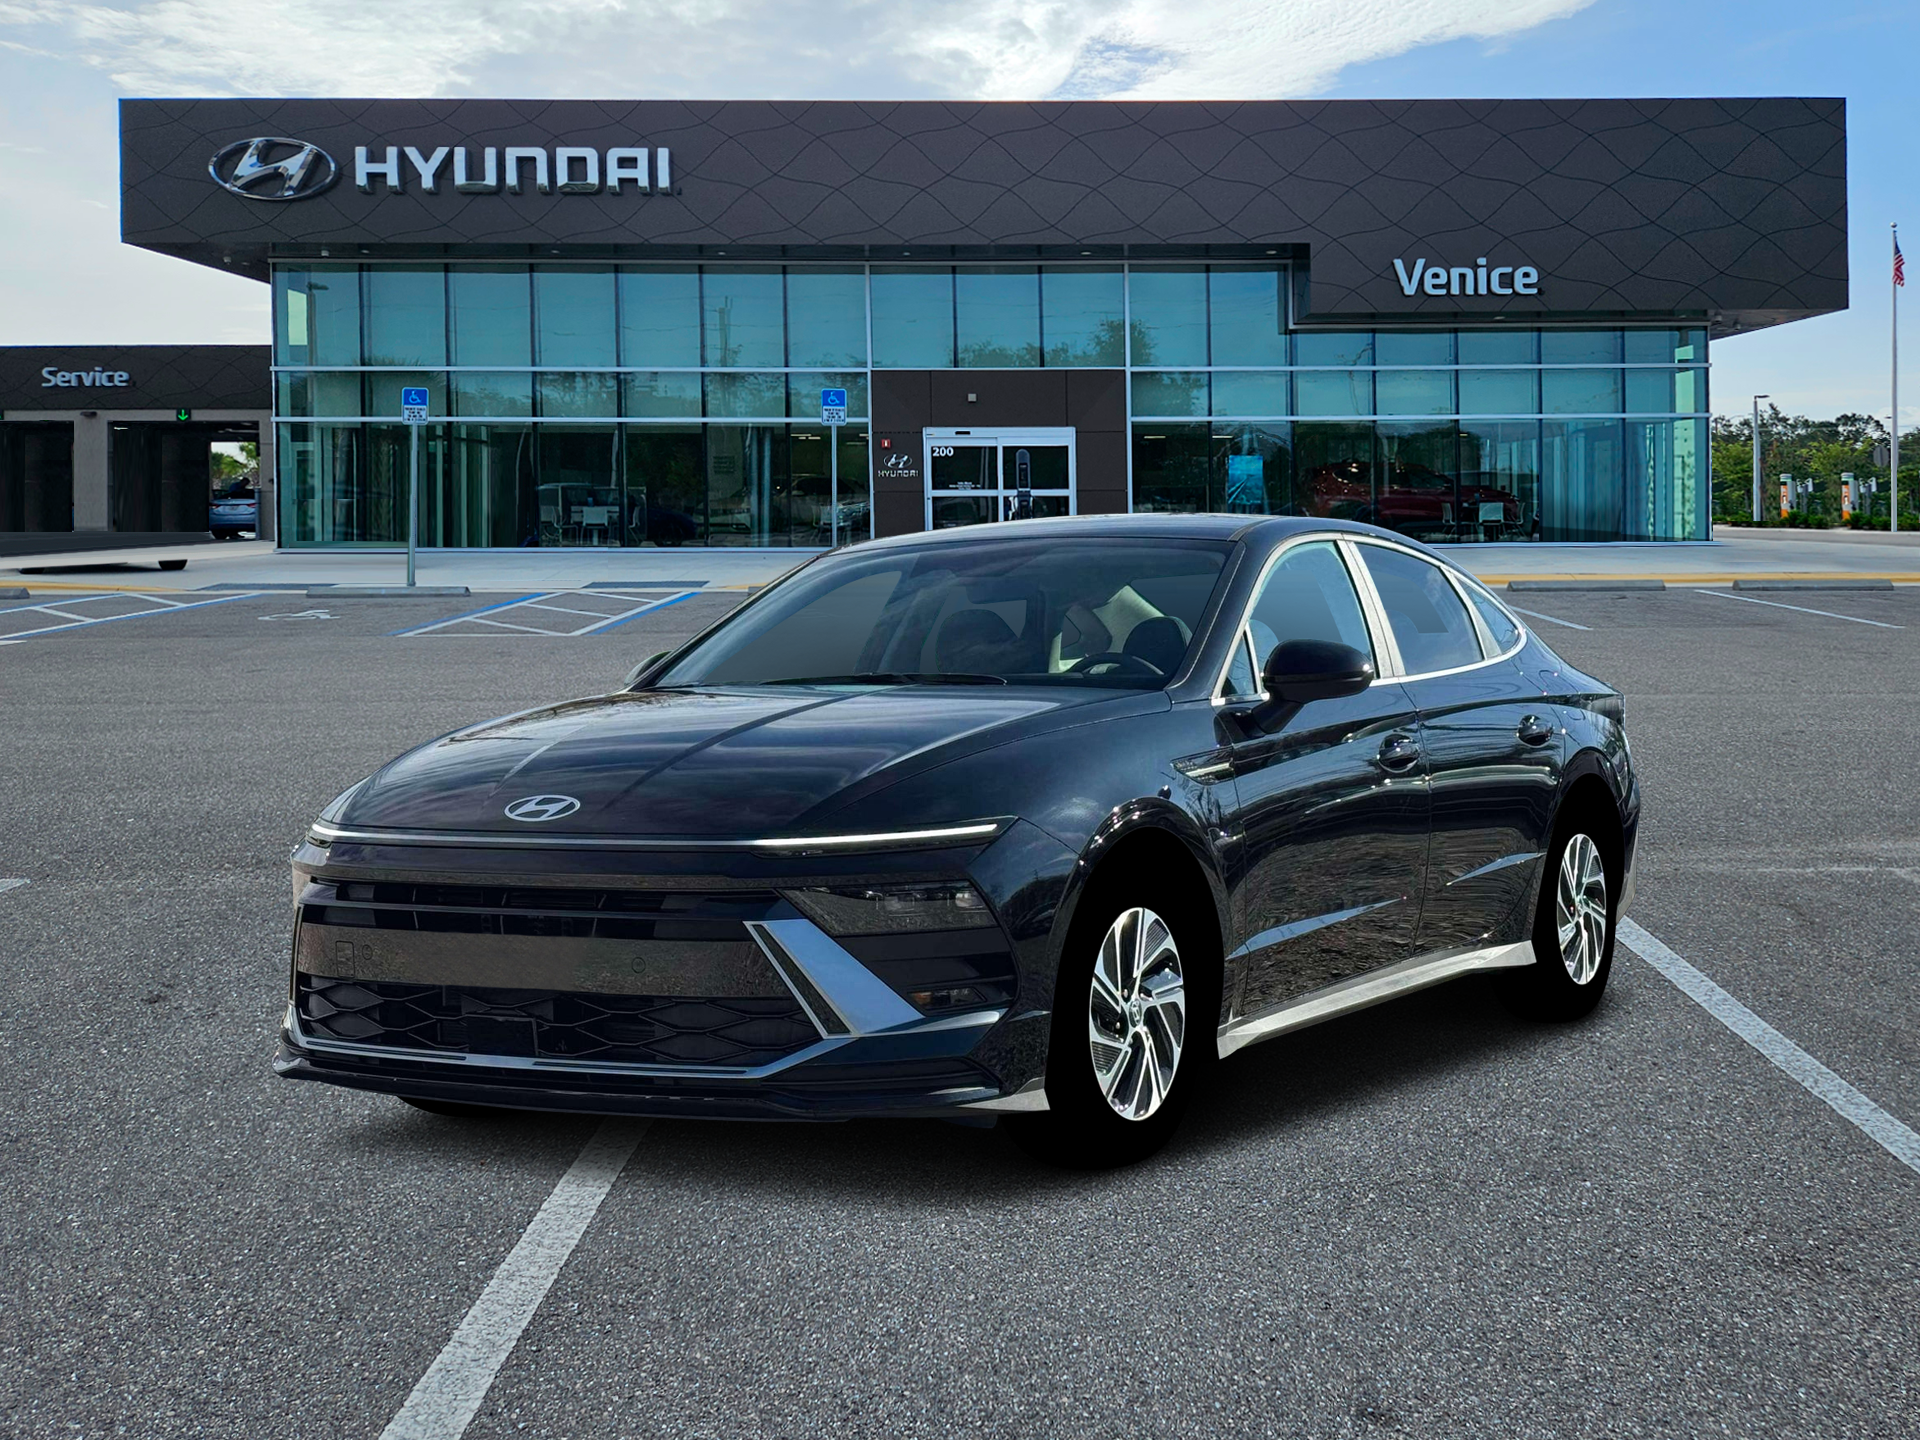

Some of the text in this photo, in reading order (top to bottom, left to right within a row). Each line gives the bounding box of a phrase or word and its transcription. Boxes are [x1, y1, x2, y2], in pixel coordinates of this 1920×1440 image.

[354, 146, 672, 195] HYUNDAI
[1393, 257, 1539, 296] Venice
[41, 366, 130, 387] Service
[932, 446, 954, 457] 200
[877, 469, 919, 478] HYUNDAI
